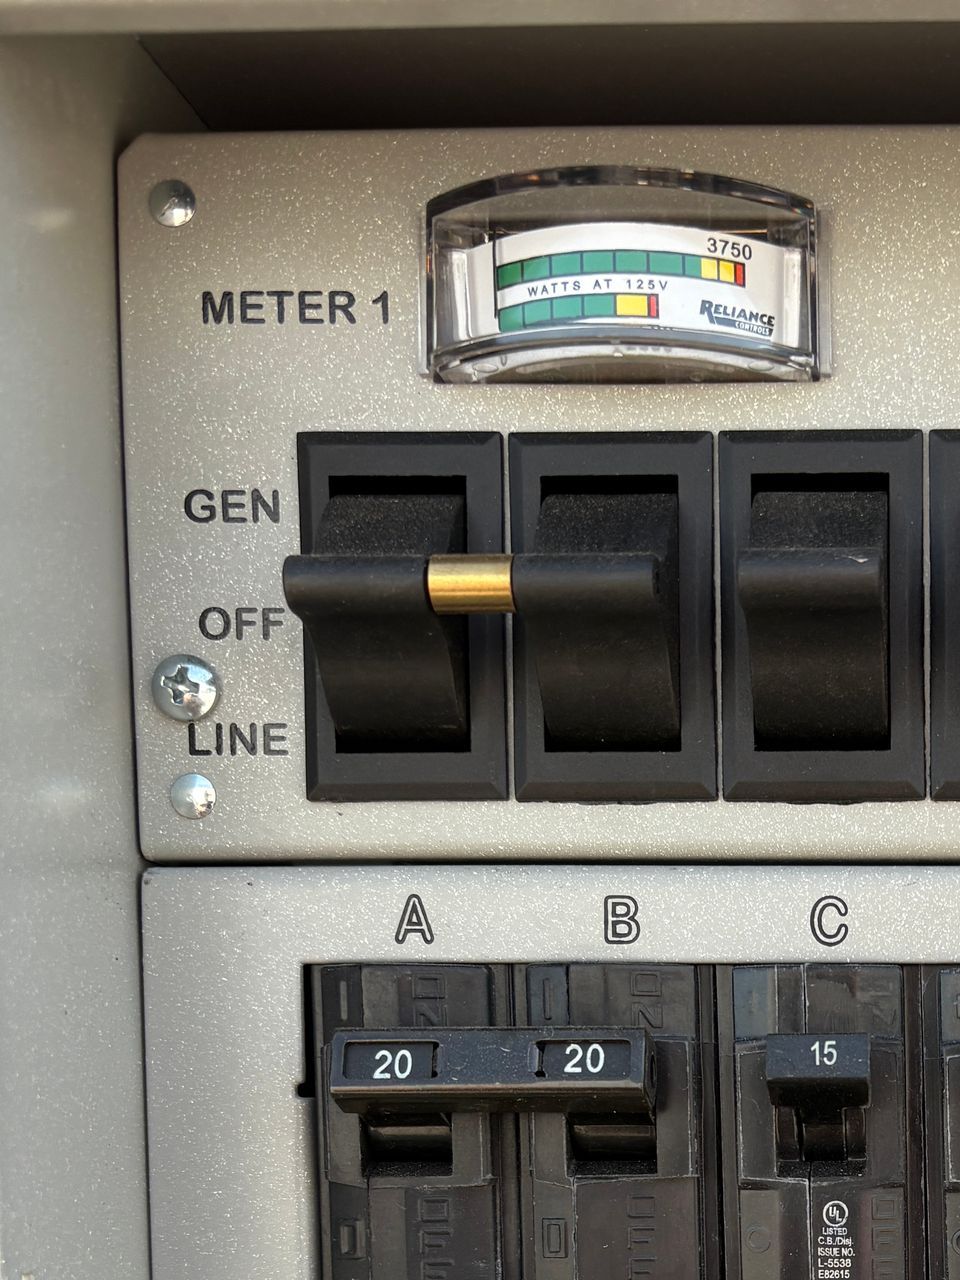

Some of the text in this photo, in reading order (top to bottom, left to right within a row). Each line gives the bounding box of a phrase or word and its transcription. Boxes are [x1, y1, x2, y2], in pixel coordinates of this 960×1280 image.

[708, 238, 752, 260] 3750
[528, 279, 667, 296] WATTS AT 125V
[202, 291, 388, 324] METER 1
[734, 321, 773, 337] CONTROLS
[184, 488, 279, 523] GEN
[199, 607, 285, 640] OFF
[187, 722, 289, 756] LINE
[395, 894, 434, 944] A
[604, 895, 640, 944] B
[810, 896, 848, 947] C
[373, 1050, 412, 1078] 20
[564, 1044, 604, 1073] 20
[811, 1041, 837, 1065] 15
[818, 1258, 851, 1267] L-5538
[819, 1270, 849, 1278] E82615
